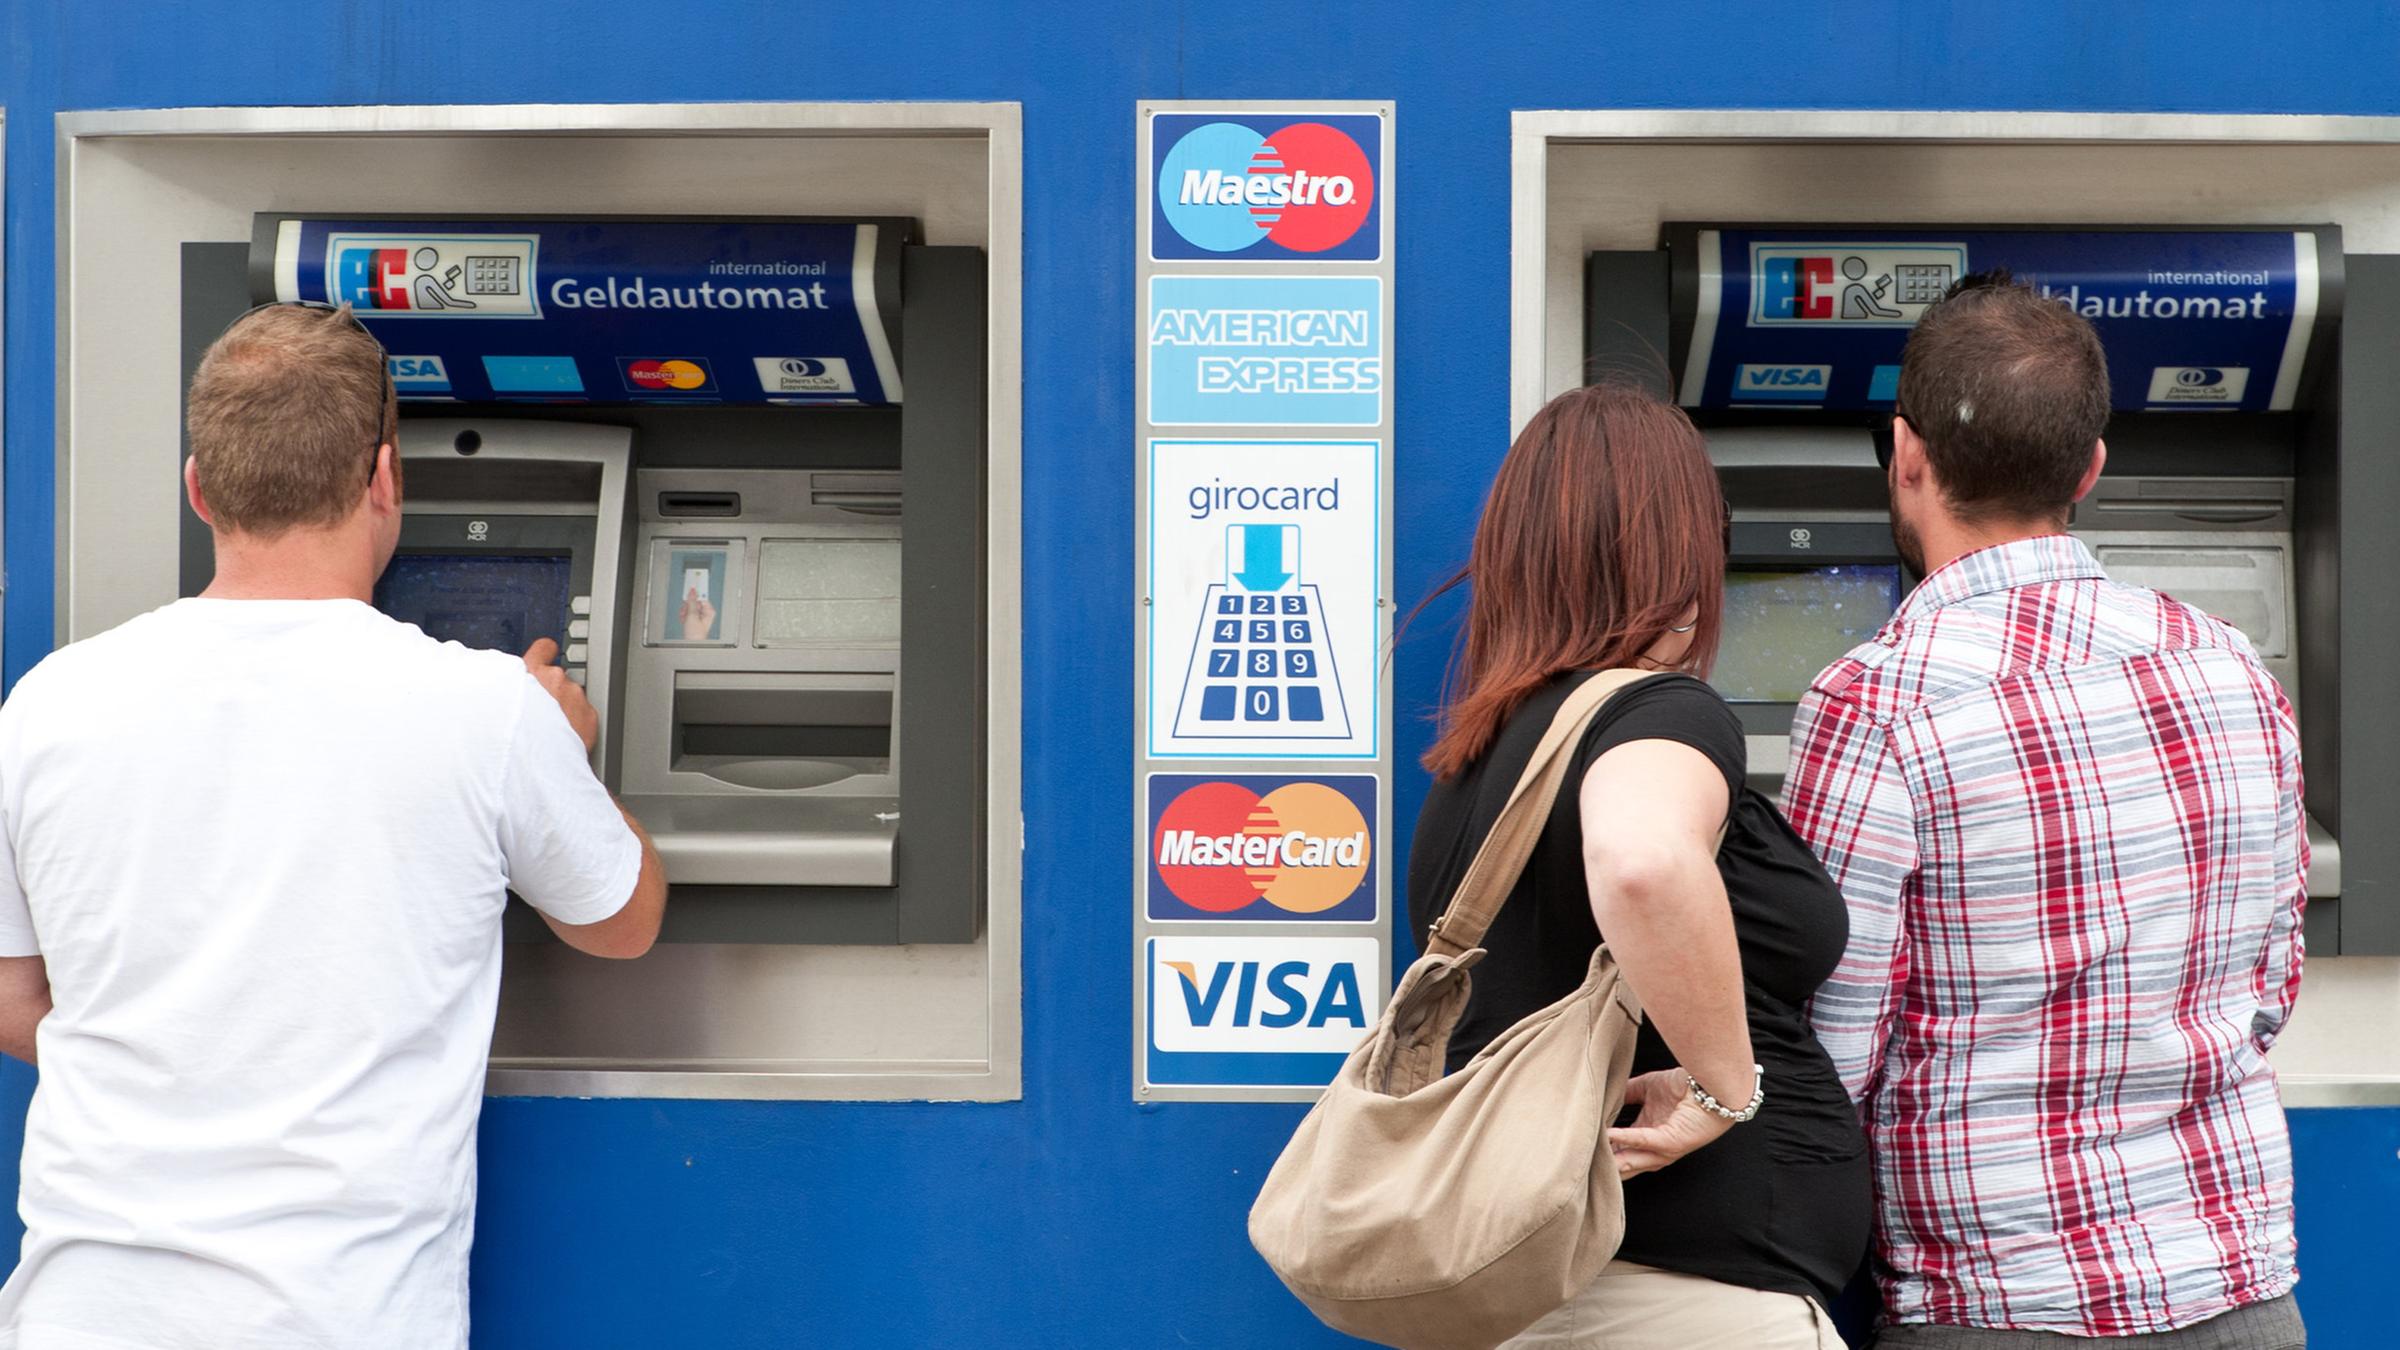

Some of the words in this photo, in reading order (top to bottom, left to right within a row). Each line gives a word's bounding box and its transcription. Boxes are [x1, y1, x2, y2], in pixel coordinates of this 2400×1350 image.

[1179, 169, 1355, 206] Maestro
[709, 260, 826, 276] international
[2148, 270, 2269, 286] international
[551, 277, 829, 310] Geldautomat
[2042, 285, 2268, 319] dautomat
[1152, 309, 1368, 346] AMERICAN
[389, 359, 441, 377] ISA
[632, 370, 703, 380] Master
[1198, 357, 1382, 394] EXPRESS
[1750, 368, 1822, 385] VISA
[1188, 477, 1339, 519] girocard
[1227, 598, 1236, 612] 1
[1256, 598, 1269, 612] 2
[1288, 598, 1301, 612] 3
[1220, 623, 1234, 639] 4
[1256, 623, 1267, 639] 5
[1290, 623, 1303, 639] 6
[1217, 653, 1231, 673] 7
[1255, 653, 1270, 673] 8
[1294, 653, 1308, 673] 9
[1253, 690, 1271, 716] 0
[1159, 829, 1366, 867] MasterCard
[1160, 960, 1367, 1029] VISA
